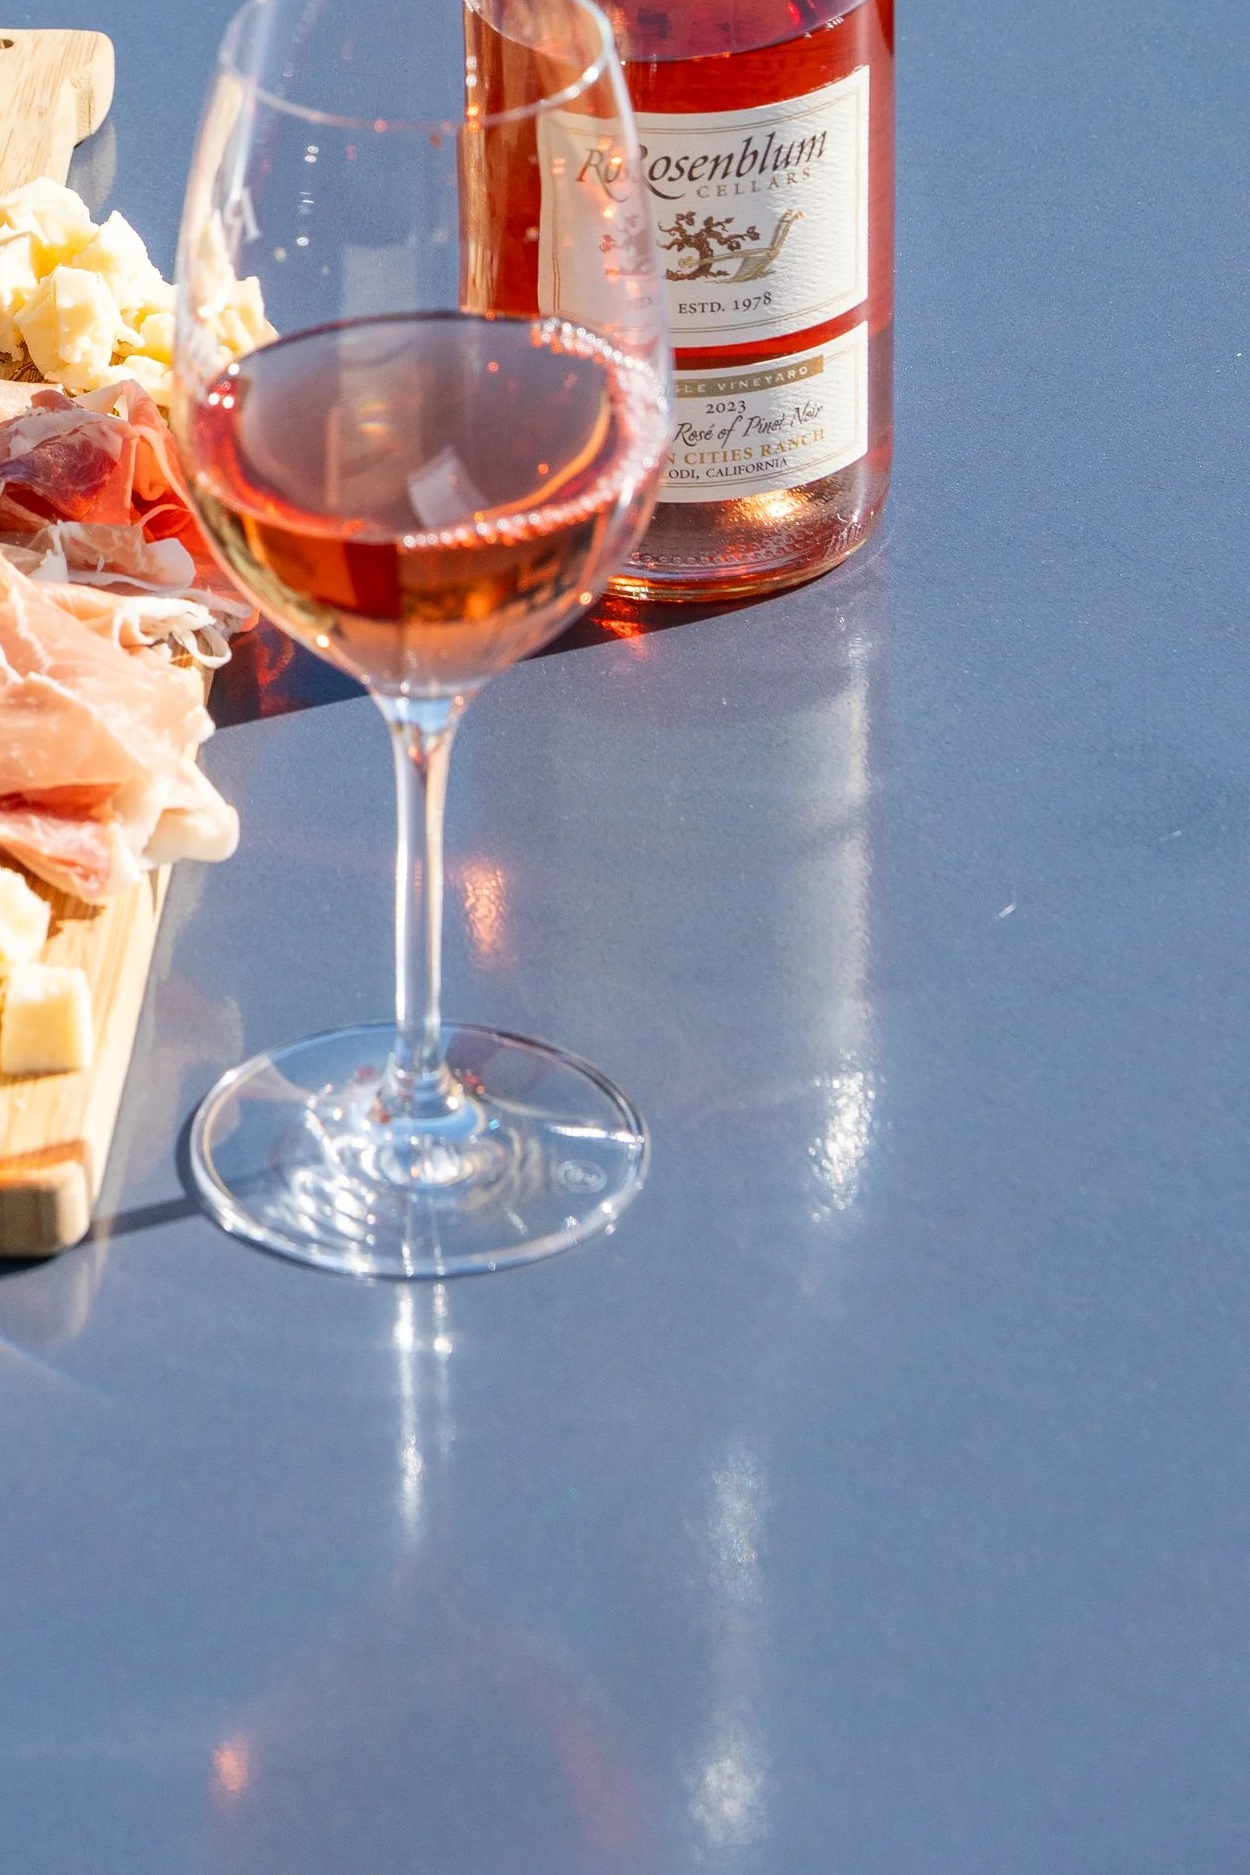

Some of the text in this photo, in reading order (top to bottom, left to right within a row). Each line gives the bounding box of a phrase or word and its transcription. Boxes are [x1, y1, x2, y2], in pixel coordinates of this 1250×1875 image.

[696, 167, 812, 199] CELLARS
[677, 291, 773, 315] ESTD. 1978
[717, 365, 809, 392] VINEYARD
[705, 399, 747, 415] 2023
[672, 399, 824, 449] Rosé of Pinot Noir
[683, 447, 754, 466] CITIES
[760, 428, 826, 458] RANCH
[705, 456, 789, 479] CALIFORNIA
